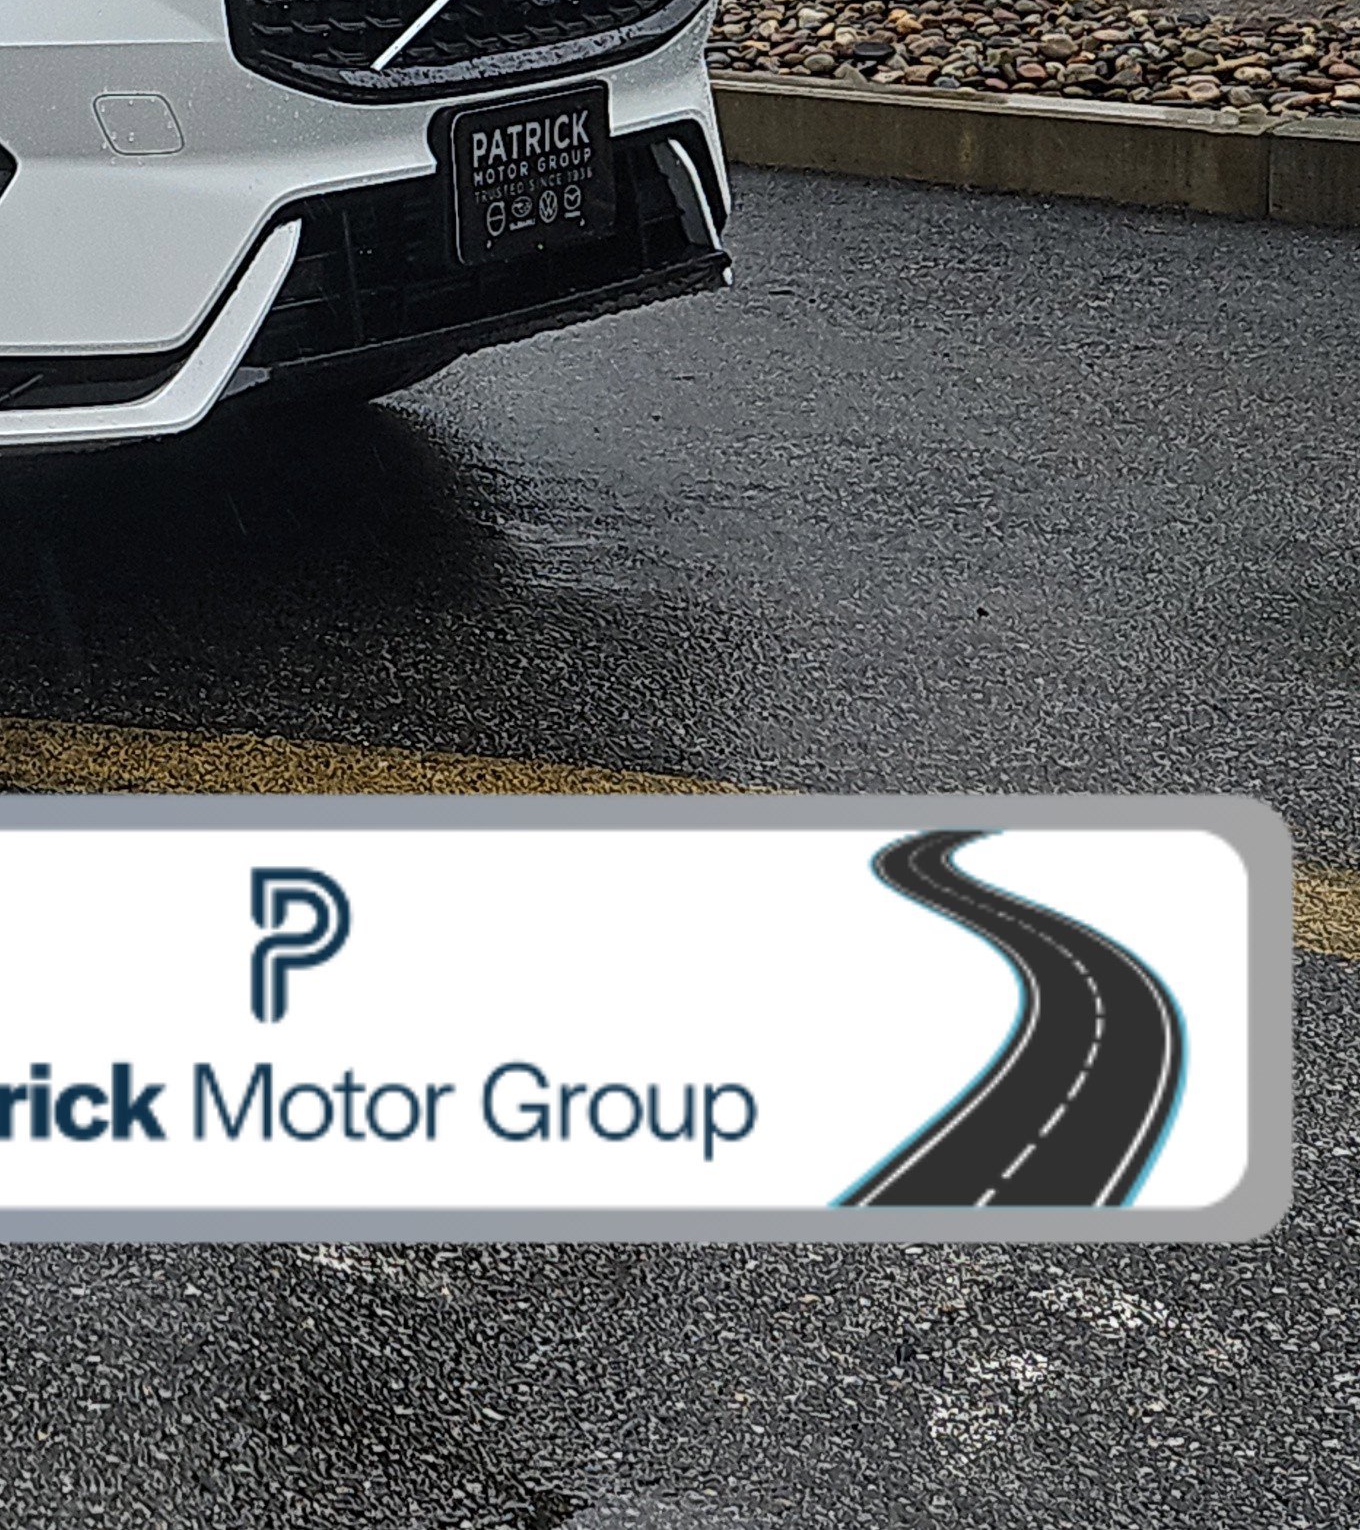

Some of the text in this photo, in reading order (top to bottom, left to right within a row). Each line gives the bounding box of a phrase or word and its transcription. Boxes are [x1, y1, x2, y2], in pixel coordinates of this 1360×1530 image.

[472, 110, 590, 168] PATRICK
[473, 147, 592, 187] MOTOR GROUP
